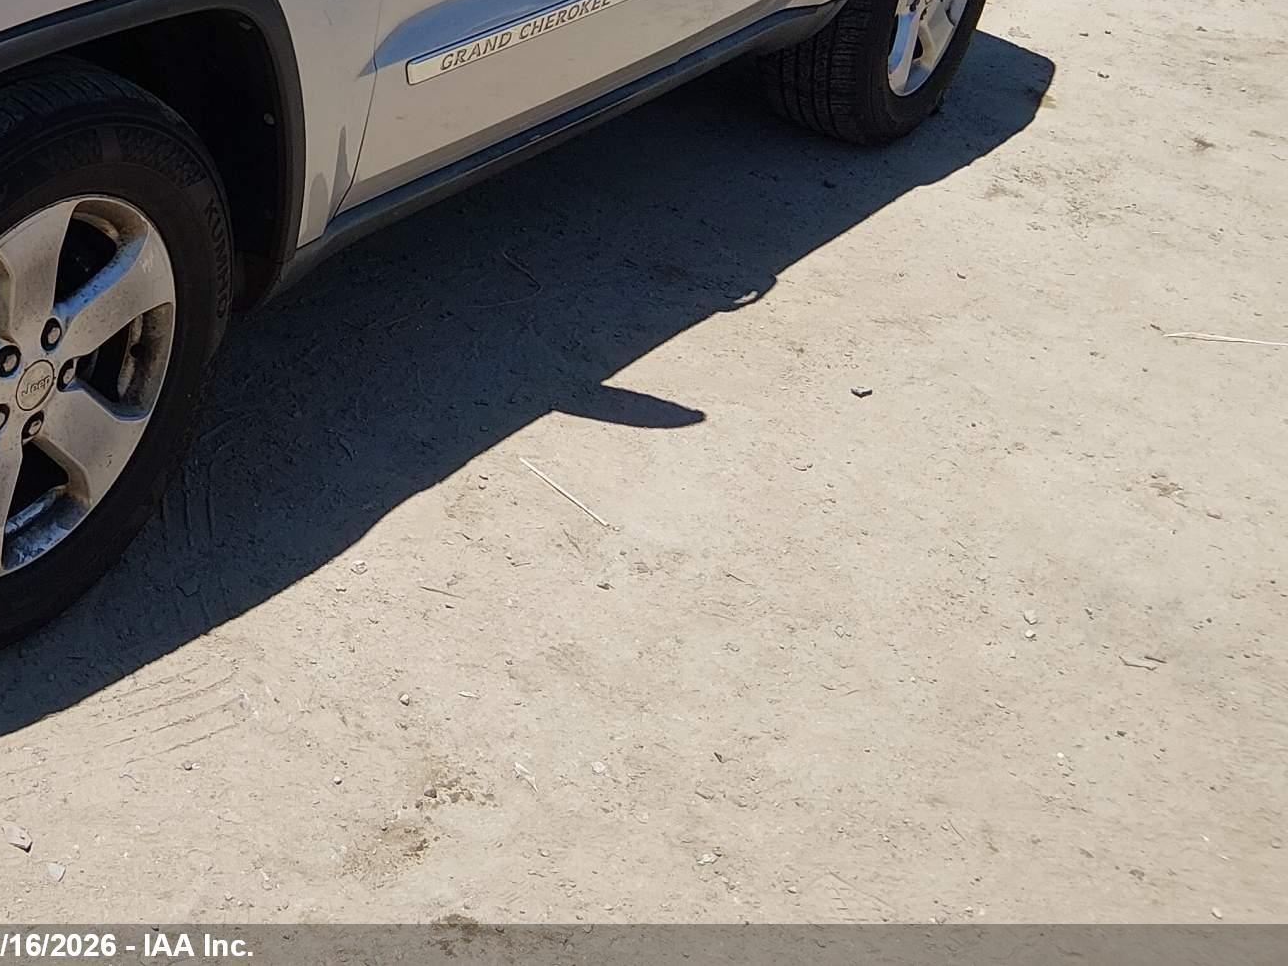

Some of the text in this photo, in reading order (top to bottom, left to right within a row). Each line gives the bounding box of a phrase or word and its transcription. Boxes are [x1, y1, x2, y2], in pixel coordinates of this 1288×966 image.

[440, 31, 513, 71] GRAND
[204, 198, 229, 319] KUMHO
[22, 375, 50, 395] Jeep
